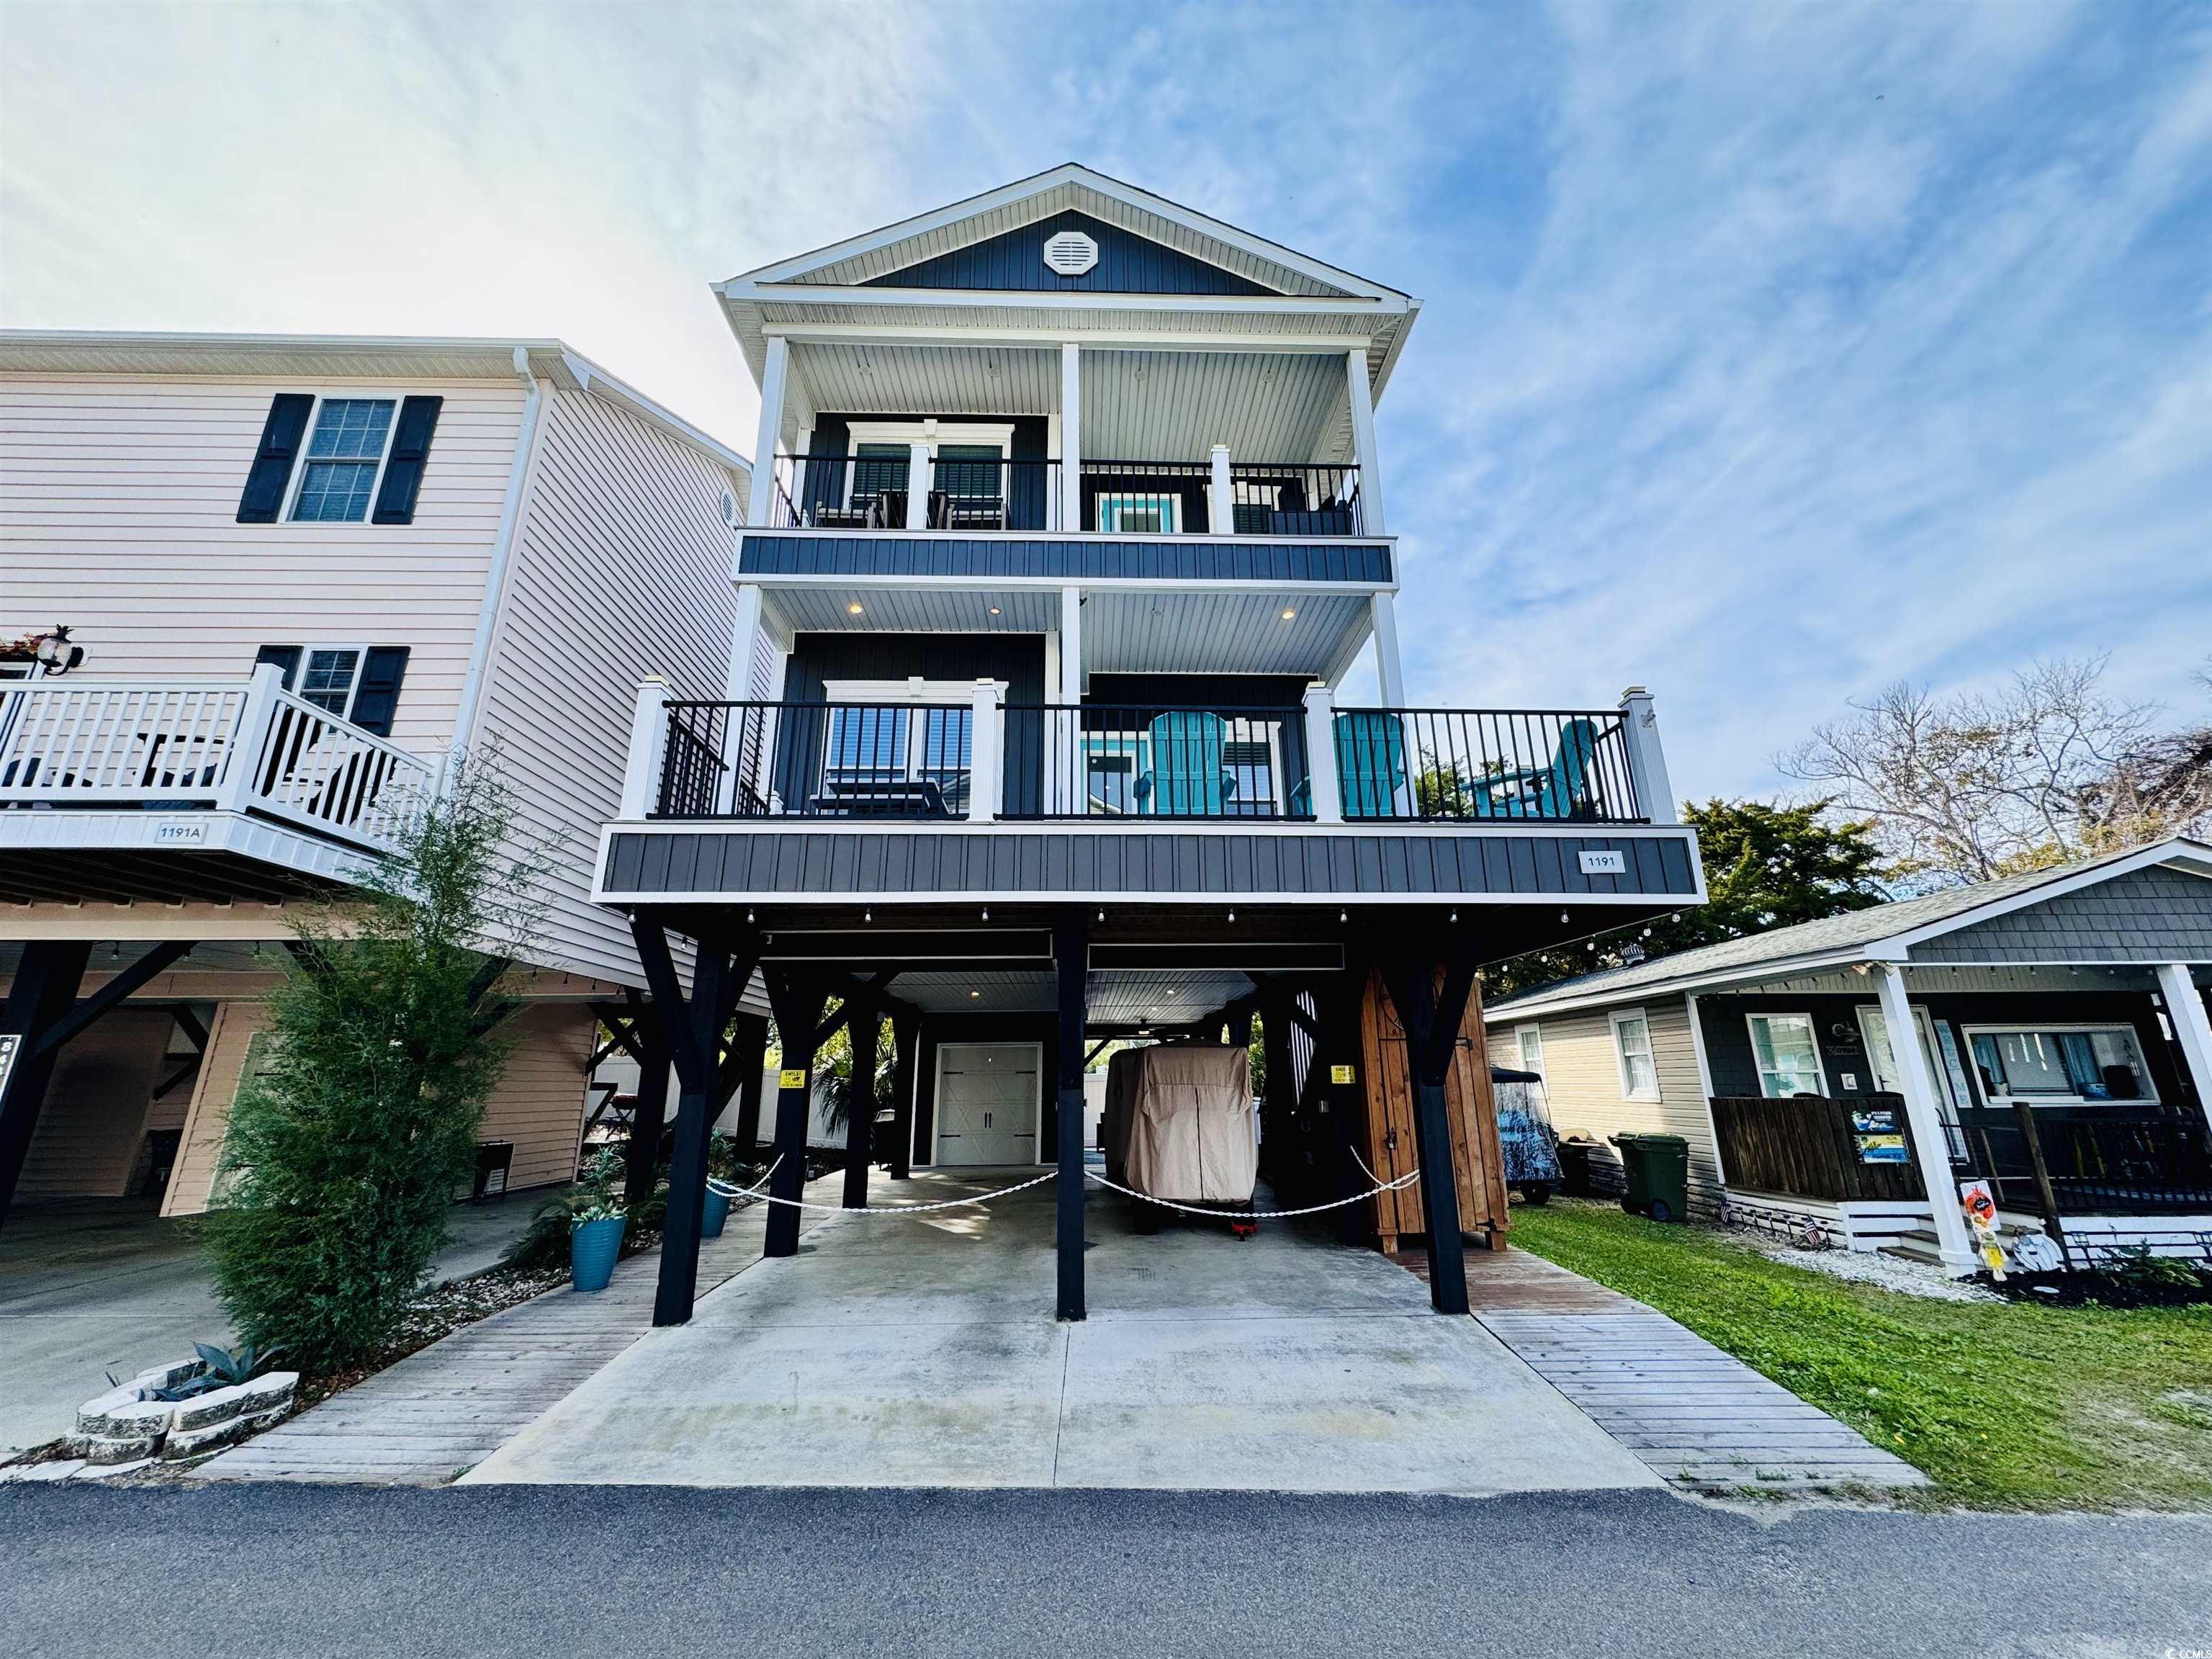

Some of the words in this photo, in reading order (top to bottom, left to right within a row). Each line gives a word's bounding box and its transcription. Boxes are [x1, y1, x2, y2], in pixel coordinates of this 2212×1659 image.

[161, 827, 200, 838] 1191A
[1588, 857, 1614, 866] 1191
[1936, 1025, 1969, 1105] WELCME
